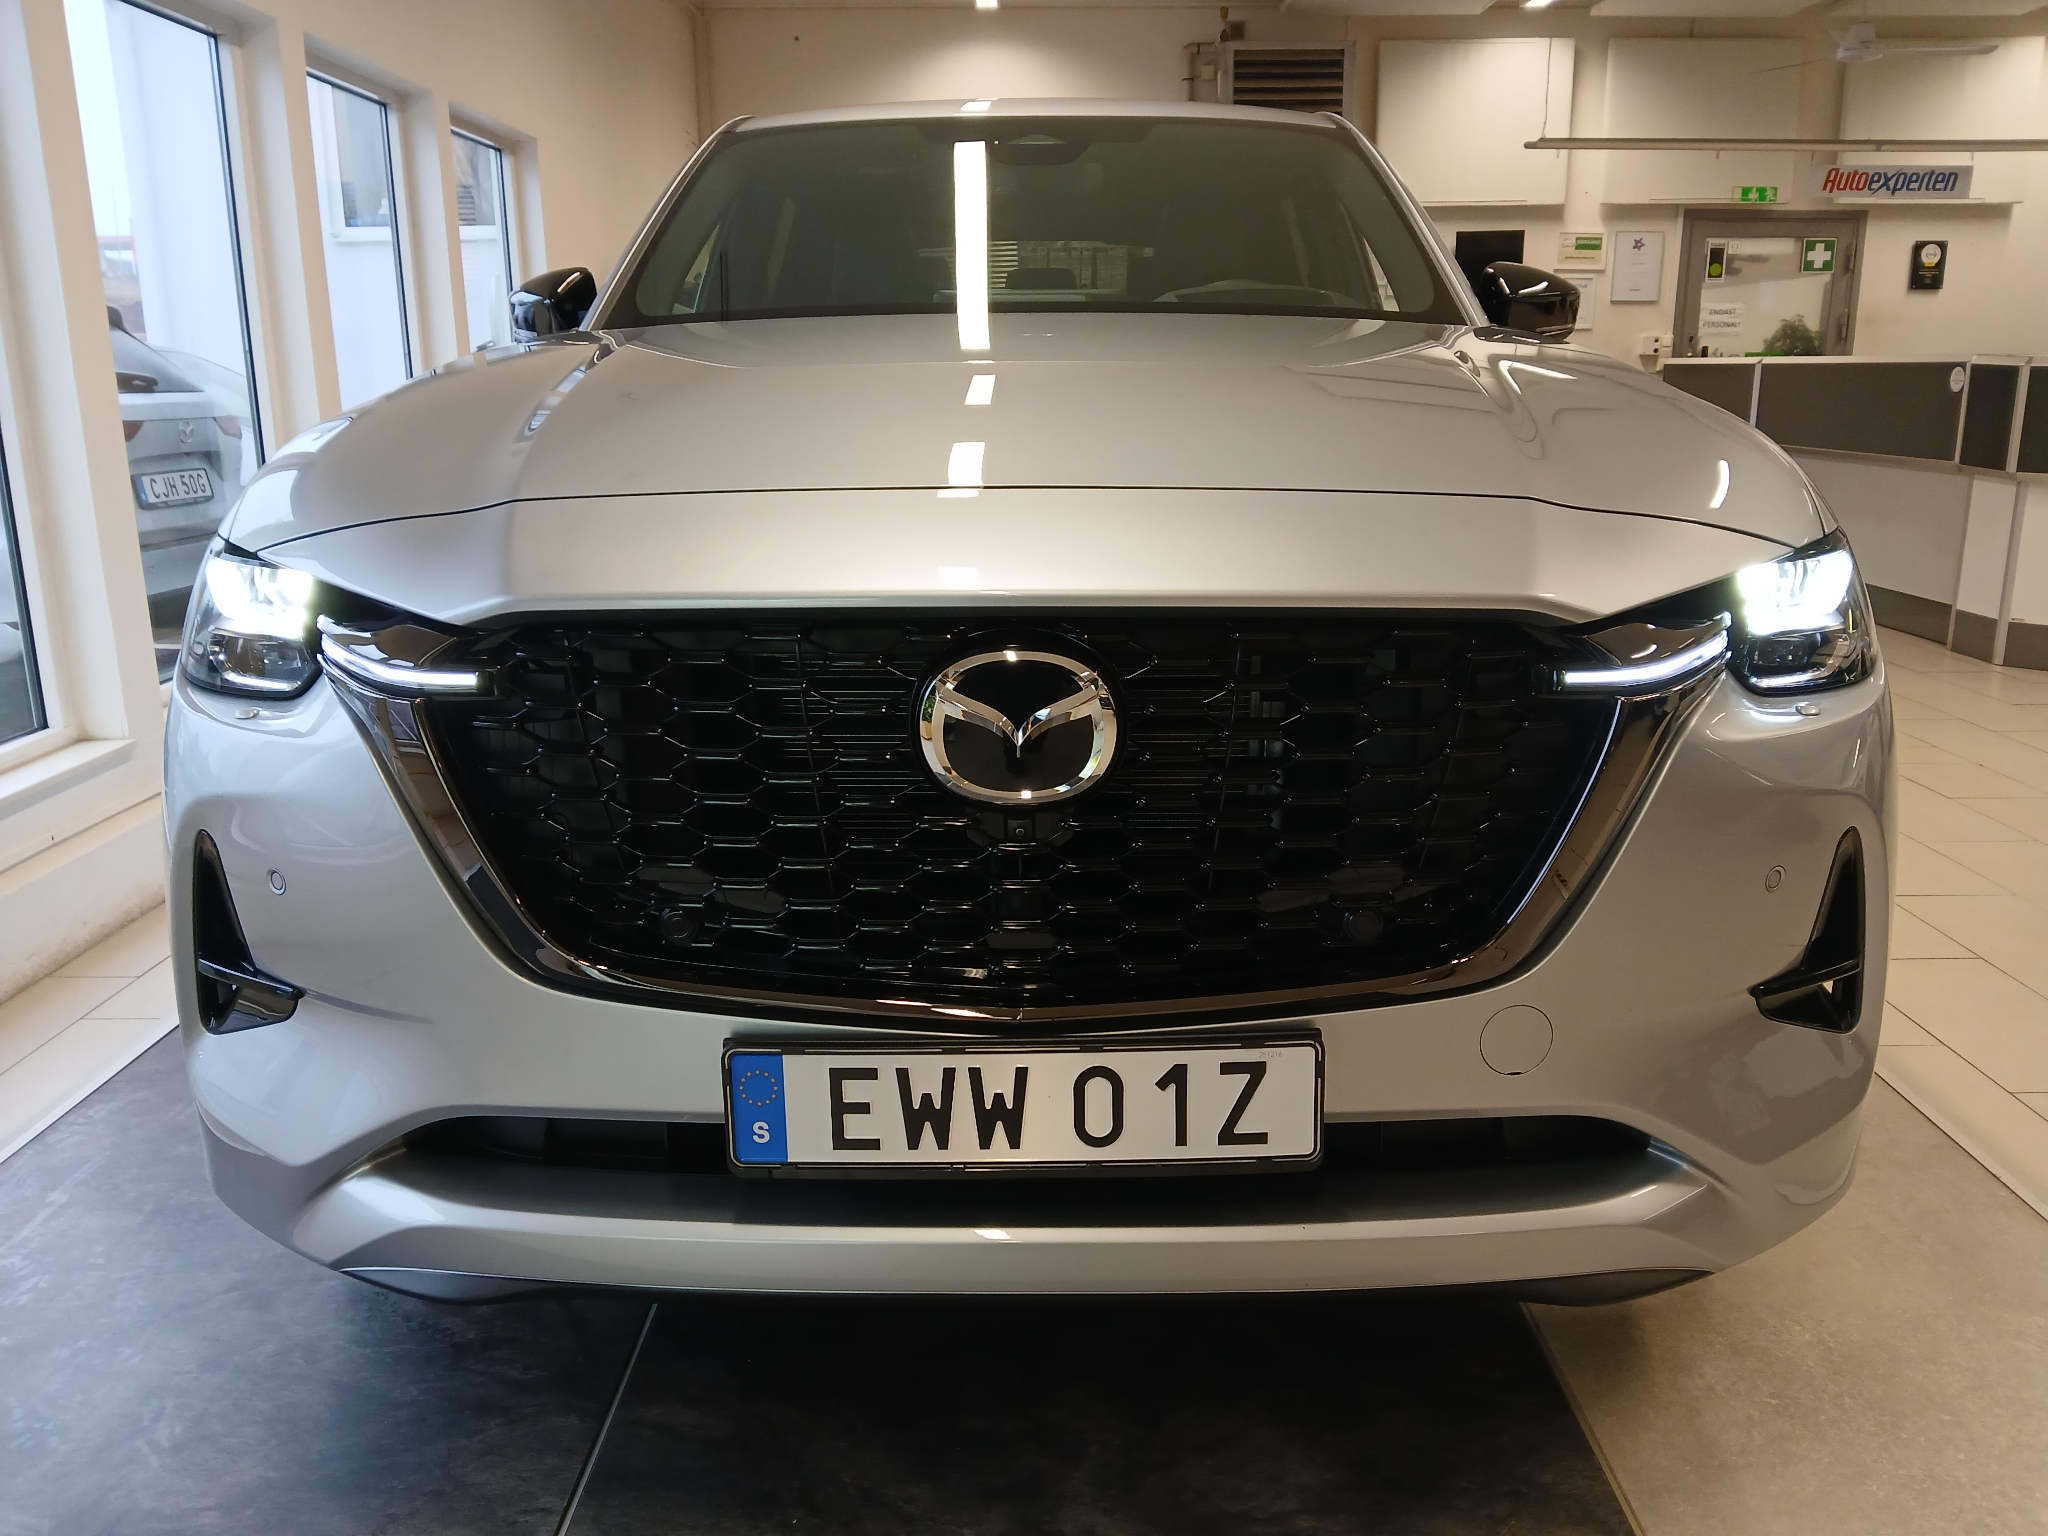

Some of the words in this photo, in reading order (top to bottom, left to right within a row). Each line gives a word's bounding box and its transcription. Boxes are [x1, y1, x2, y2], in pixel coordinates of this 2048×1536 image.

[1822, 167, 1959, 196] Autoexperten
[1709, 308, 1737, 316] ENDAST
[149, 475, 180, 499] CJH
[828, 1066, 1030, 1151] EWW
[1073, 1060, 1269, 1149] 01Z
[752, 1121, 771, 1144] S
